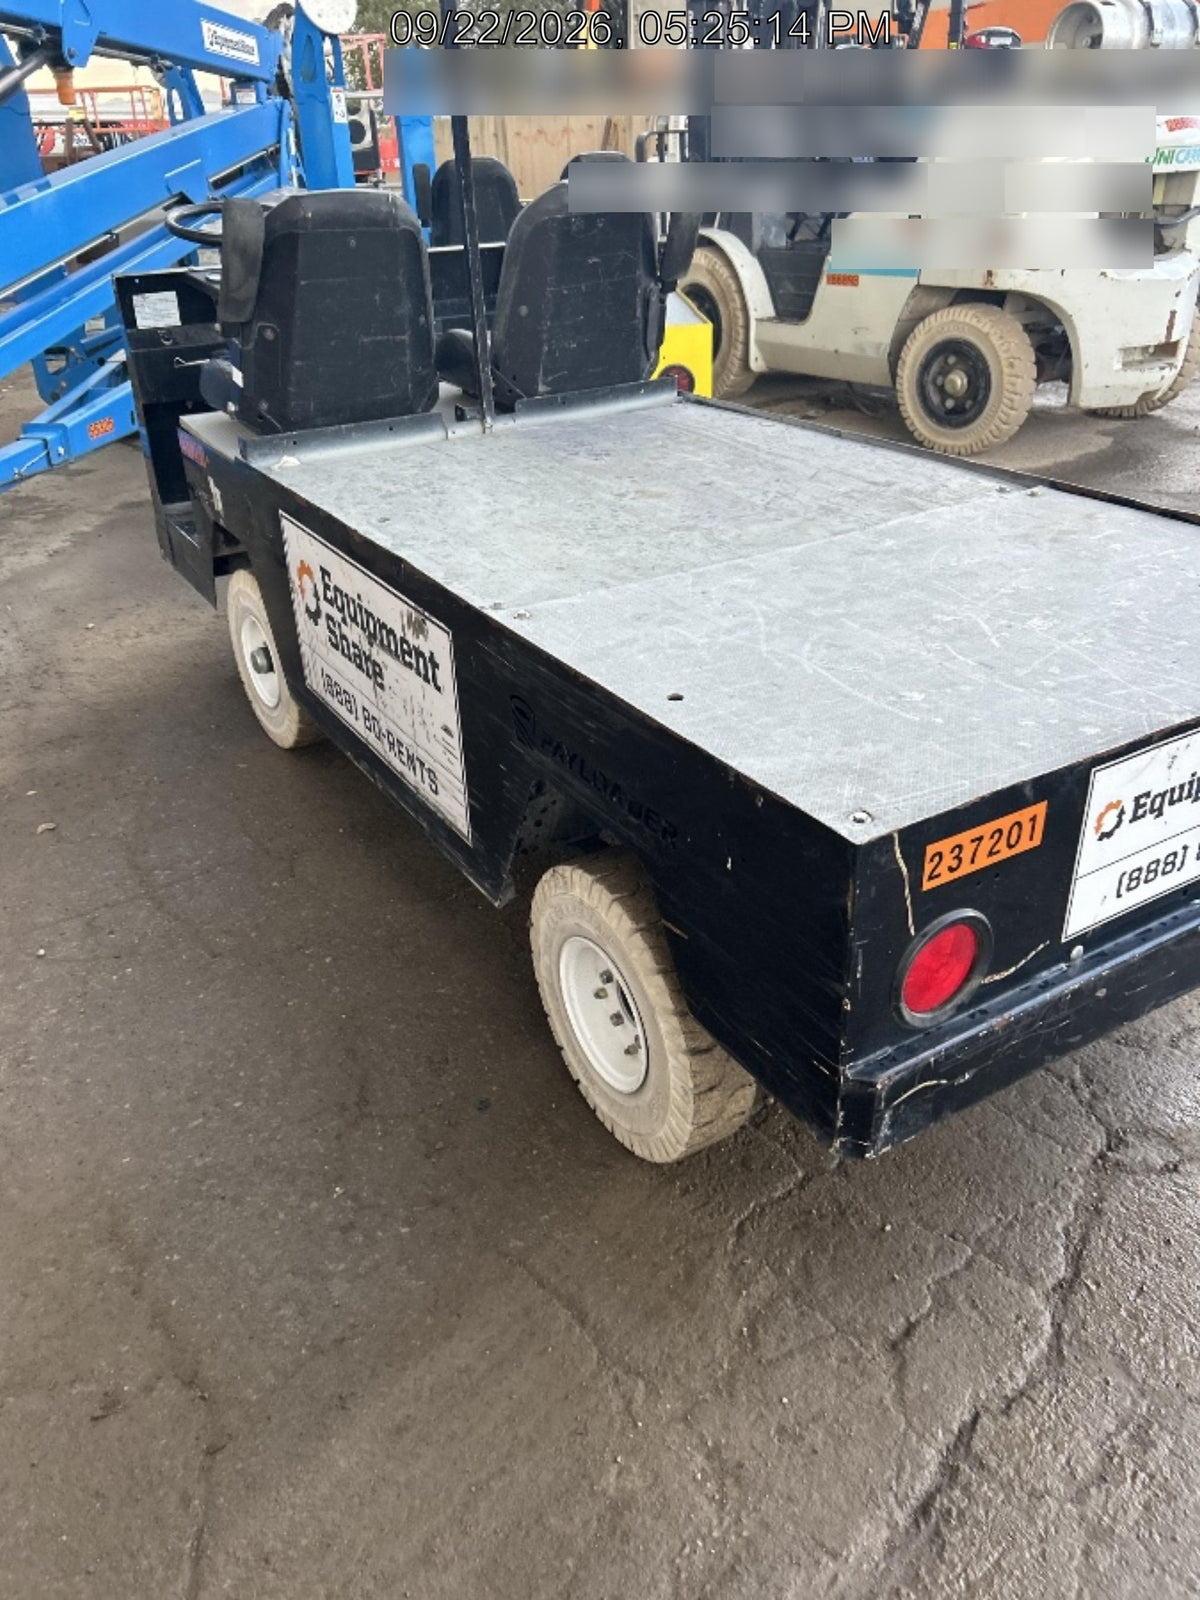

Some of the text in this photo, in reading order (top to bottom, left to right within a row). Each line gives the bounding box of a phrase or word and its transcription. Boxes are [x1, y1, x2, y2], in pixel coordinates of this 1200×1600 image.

[319, 564, 443, 694] Equipment
[325, 612, 386, 692] Share
[321, 666, 359, 721] (888)
[926, 813, 1038, 882] 237201
[1115, 844, 1189, 899] (888)
